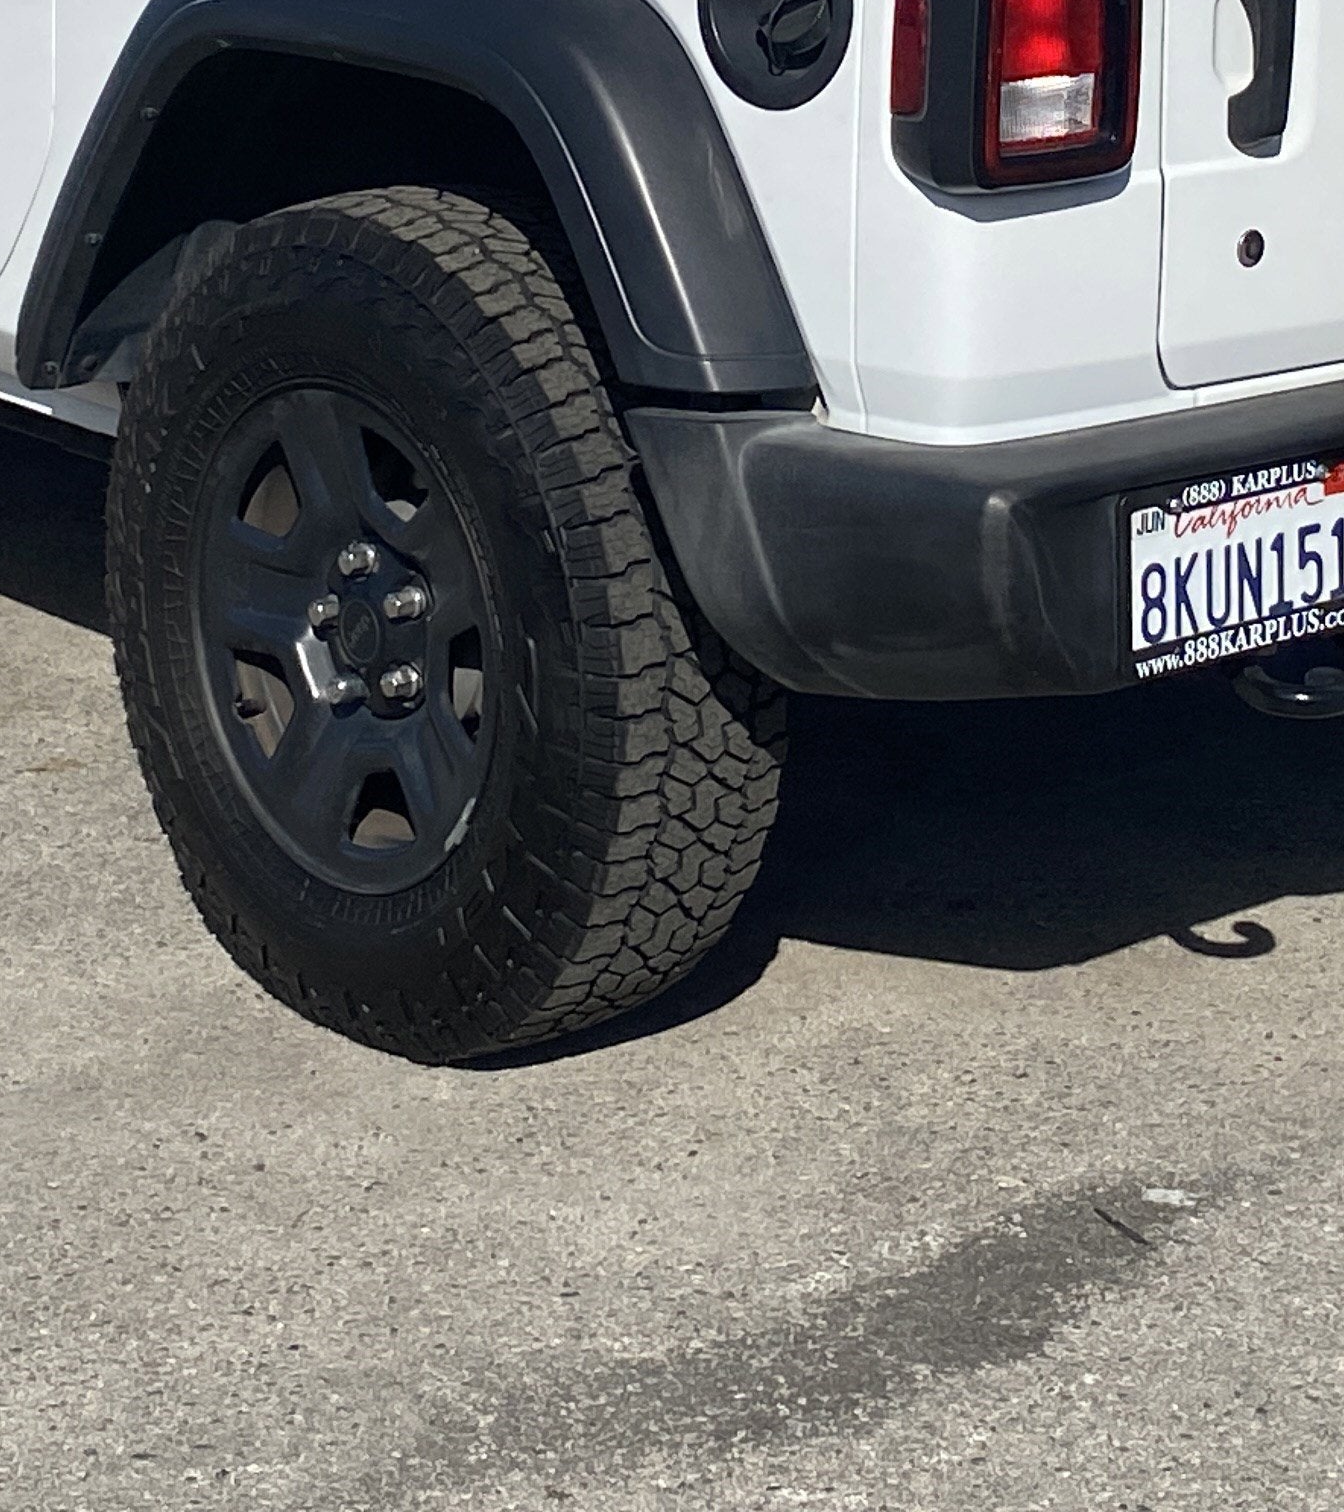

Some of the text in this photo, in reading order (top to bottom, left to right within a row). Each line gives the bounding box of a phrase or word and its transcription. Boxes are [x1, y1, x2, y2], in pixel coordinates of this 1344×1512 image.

[1183, 478, 1226, 506] (888)
[1232, 460, 1317, 497] KARPLUS
[1136, 512, 1166, 535] JUN
